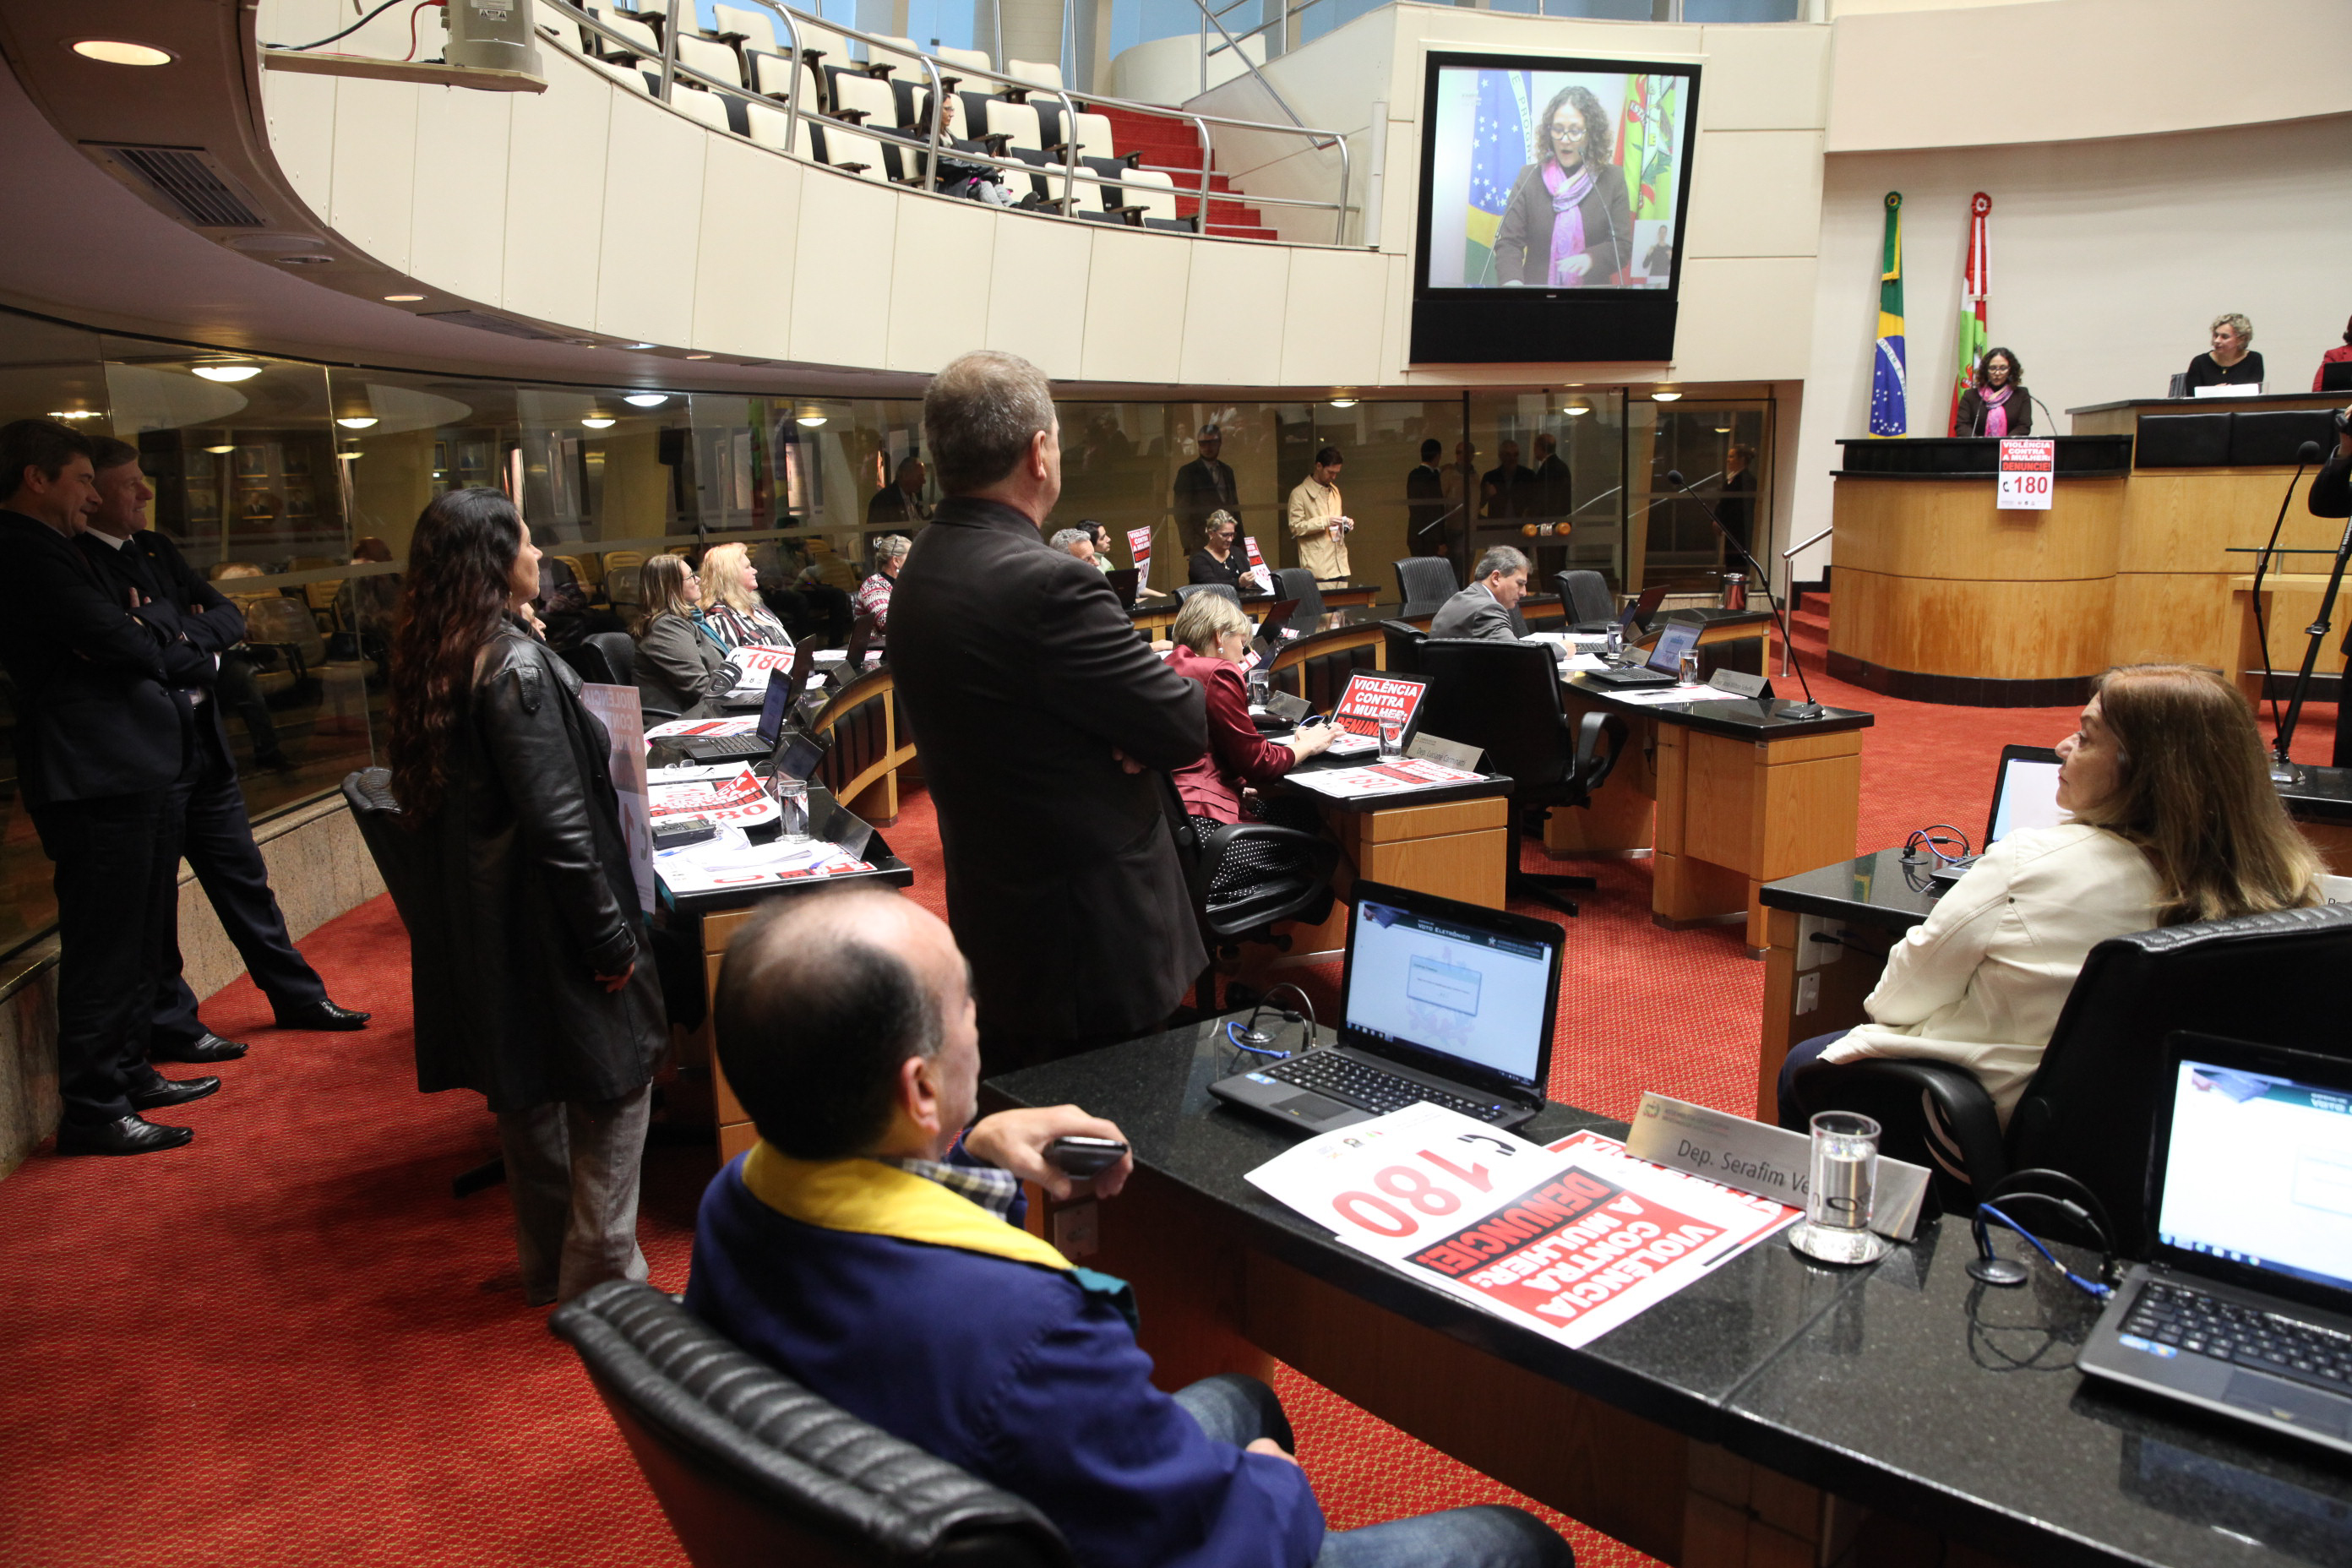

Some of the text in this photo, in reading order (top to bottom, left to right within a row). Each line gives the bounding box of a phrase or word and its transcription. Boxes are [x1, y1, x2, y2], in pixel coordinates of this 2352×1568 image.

[2003, 461, 2050, 471] DENUNCIE!
[2014, 476, 2048, 493] 180
[747, 653, 791, 671] 180
[1354, 679, 1418, 697] VIOLÊNCIA
[1355, 692, 1404, 708] CONTRA
[1342, 703, 1407, 721] A MULHER:
[1338, 775, 1400, 788] 180
[1677, 1139, 1713, 1168] Dep.
[1720, 1152, 1784, 1186] Serafim
[1332, 1149, 1494, 1238] 180
[1415, 1172, 1611, 1274] DENUNCIE!
[1468, 1195, 1644, 1288] A MULHER:
[1522, 1221, 1661, 1293] CONTRA
[1536, 1224, 1717, 1319] VIOLÊNCIA
